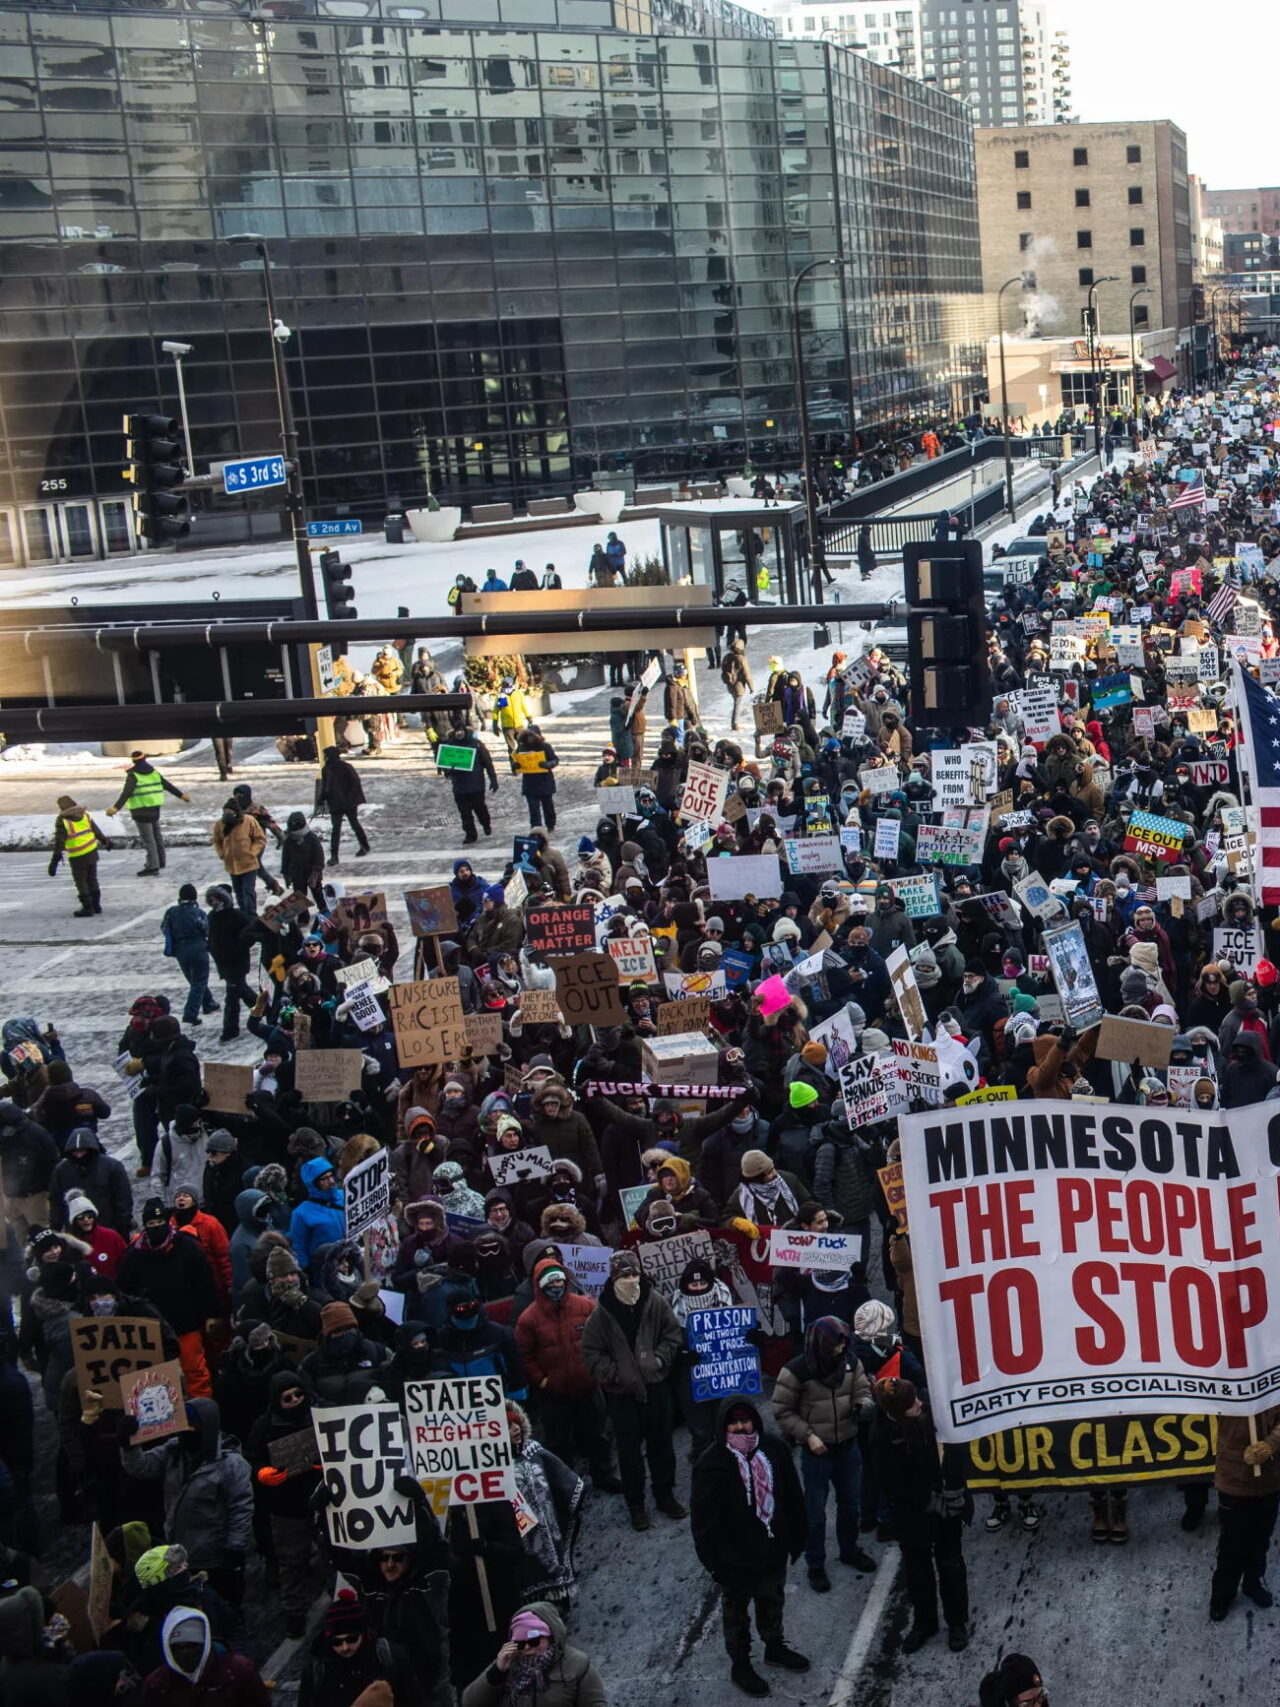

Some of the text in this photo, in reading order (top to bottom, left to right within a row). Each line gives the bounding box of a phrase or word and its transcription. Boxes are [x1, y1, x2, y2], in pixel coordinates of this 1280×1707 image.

[239, 462, 283, 484] S 3rd St
[41, 479, 67, 491] 255
[310, 523, 358, 533] S 2nd Av
[1008, 560, 1027, 572] ICE
[1007, 571, 1028, 583] OUT
[320, 650, 330, 662] ONE
[320, 664, 331, 673] WAY
[944, 755, 962, 766] WHO
[935, 770, 969, 781] BENEFITS
[687, 775, 718, 801] ICE
[943, 784, 964, 794] FROM
[683, 794, 717, 819] OUT!
[807, 822, 830, 832] MAN
[1128, 825, 1182, 849] ICE OUT
[1226, 839, 1244, 850] ICE
[918, 842, 964, 854] PROTECT
[1136, 840, 1166, 857] MSP
[899, 885, 925, 897] MAKE
[529, 908, 591, 925] ORANGE
[905, 903, 939, 917] GREAT
[544, 922, 575, 936] LIES
[532, 934, 593, 949] MATTER
[609, 939, 649, 957] MELT
[1222, 931, 1255, 950] ICE
[622, 956, 646, 972] ICE
[556, 961, 606, 987] ICE
[391, 979, 460, 1009] INSECURE
[566, 983, 617, 1012] OUT
[354, 1005, 377, 1021] GOOD
[396, 1003, 459, 1032] RACIST
[893, 1039, 938, 1063] NO KINGS
[841, 1056, 876, 1085] SAY
[897, 1069, 940, 1087] NO SECRET
[1169, 1068, 1199, 1077] WE ARE
[587, 1081, 747, 1100] FUCK TRUMP
[986, 1091, 1008, 1102] OUT
[850, 1104, 889, 1130] BITCHES
[925, 1119, 1240, 1184] MINNESOTA
[347, 1157, 387, 1202] STOP
[347, 1185, 387, 1219] ICE TERROR
[930, 1185, 1039, 1269] THE
[1060, 1178, 1261, 1263] PEOPLE
[571, 1247, 581, 1257] IF
[653, 1238, 694, 1252] YOUR
[818, 1237, 848, 1250] FUCK
[643, 1242, 712, 1270] SILENCE
[775, 1248, 799, 1262] WITH
[574, 1261, 607, 1273] UNSAFE
[692, 1308, 751, 1332] PRISON
[938, 1266, 1044, 1387] TO
[1072, 1260, 1269, 1369] STOP
[76, 1324, 157, 1351] JAIL
[703, 1327, 741, 1341] WITHOUT
[696, 1341, 713, 1353] DUE
[711, 1351, 732, 1362] IS A
[693, 1356, 757, 1379] CONCENTRATION
[711, 1373, 741, 1390] CAMP
[408, 1378, 502, 1414] STATES
[960, 1387, 1033, 1418] PARTY
[1037, 1381, 1086, 1398] FOR
[1091, 1378, 1217, 1396] SOCIALISM
[1221, 1383, 1233, 1395] &
[424, 1410, 488, 1427] HAVE
[318, 1411, 404, 1462] ICE
[416, 1422, 502, 1444] RIGHTS
[967, 1427, 1056, 1474] OUR
[416, 1441, 510, 1479] ABOLISH
[323, 1458, 407, 1508] OUT
[331, 1500, 416, 1544] NOW
